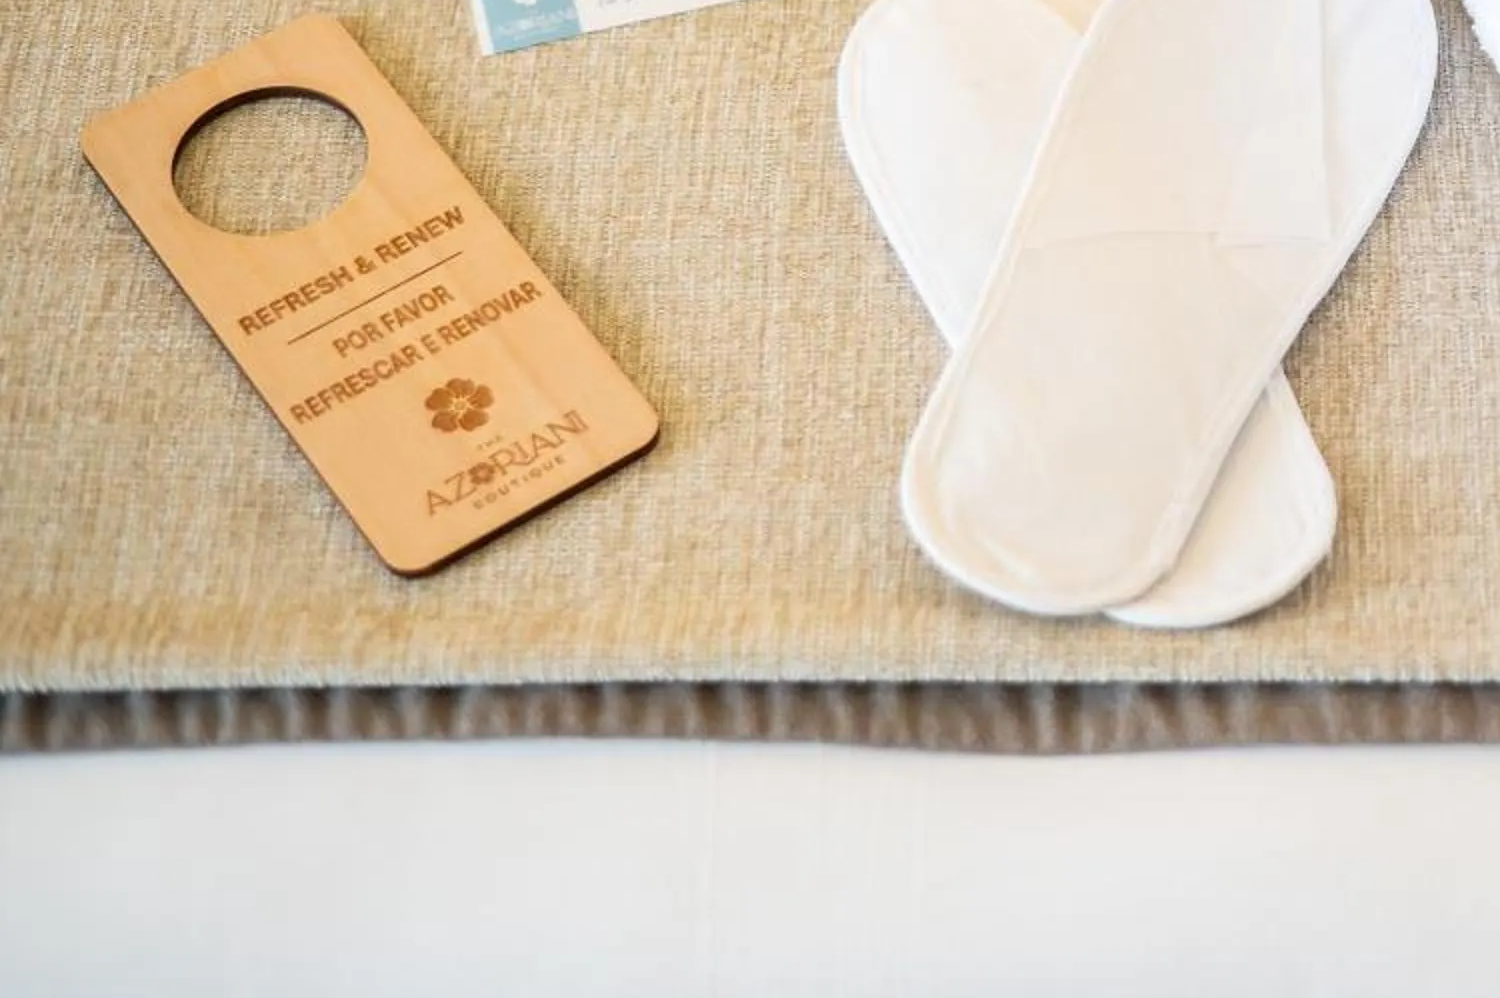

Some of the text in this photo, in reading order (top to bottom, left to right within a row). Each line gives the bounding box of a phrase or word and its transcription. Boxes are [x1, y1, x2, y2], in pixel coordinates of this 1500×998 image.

[237, 205, 464, 335] REFRESH & RENEW
[290, 281, 541, 423] REFRESCAR E RENOVAR
[331, 285, 454, 358] POR FAVOR
[472, 455, 563, 509] BOUTIQUE
